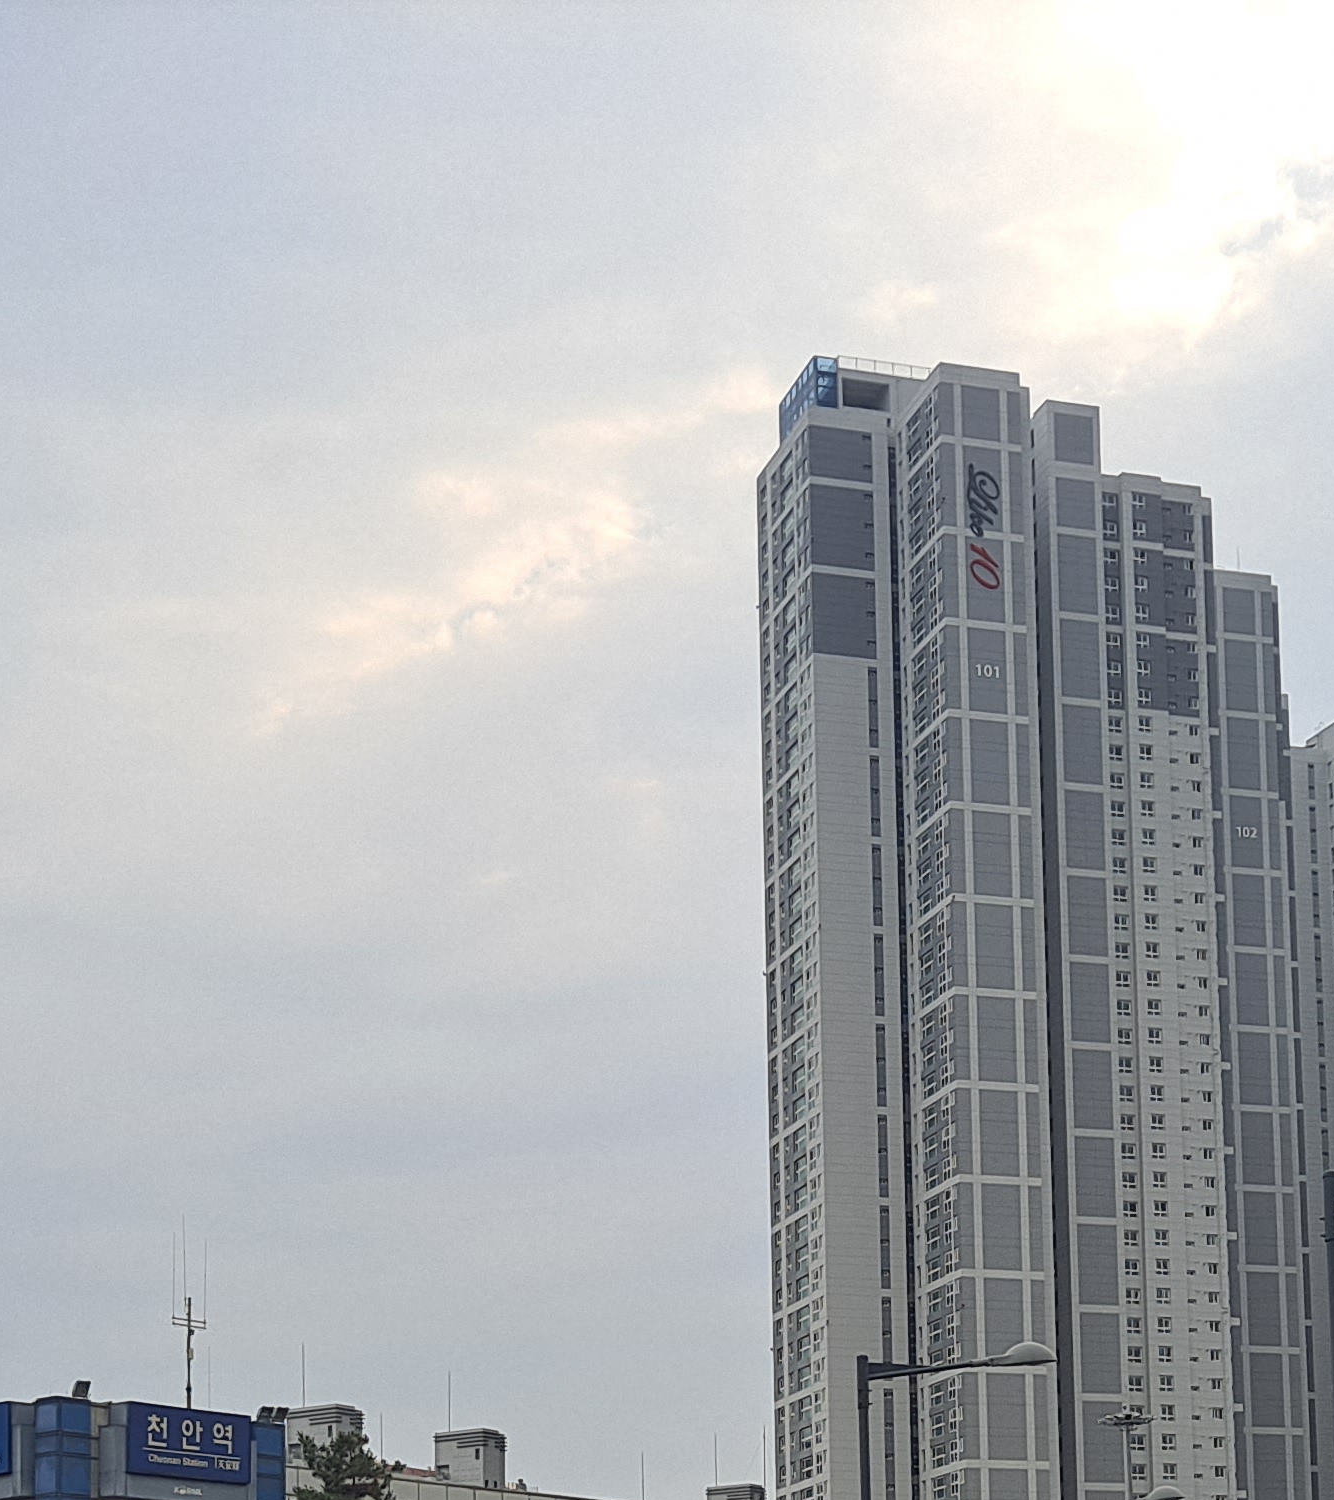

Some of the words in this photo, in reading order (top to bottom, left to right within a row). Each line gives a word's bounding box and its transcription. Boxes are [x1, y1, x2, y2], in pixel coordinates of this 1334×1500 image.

[970, 543, 1001, 590] 10
[975, 662, 1001, 679] 101
[1235, 826, 1258, 839] 102
[147, 1413, 233, 1455] 천안역
